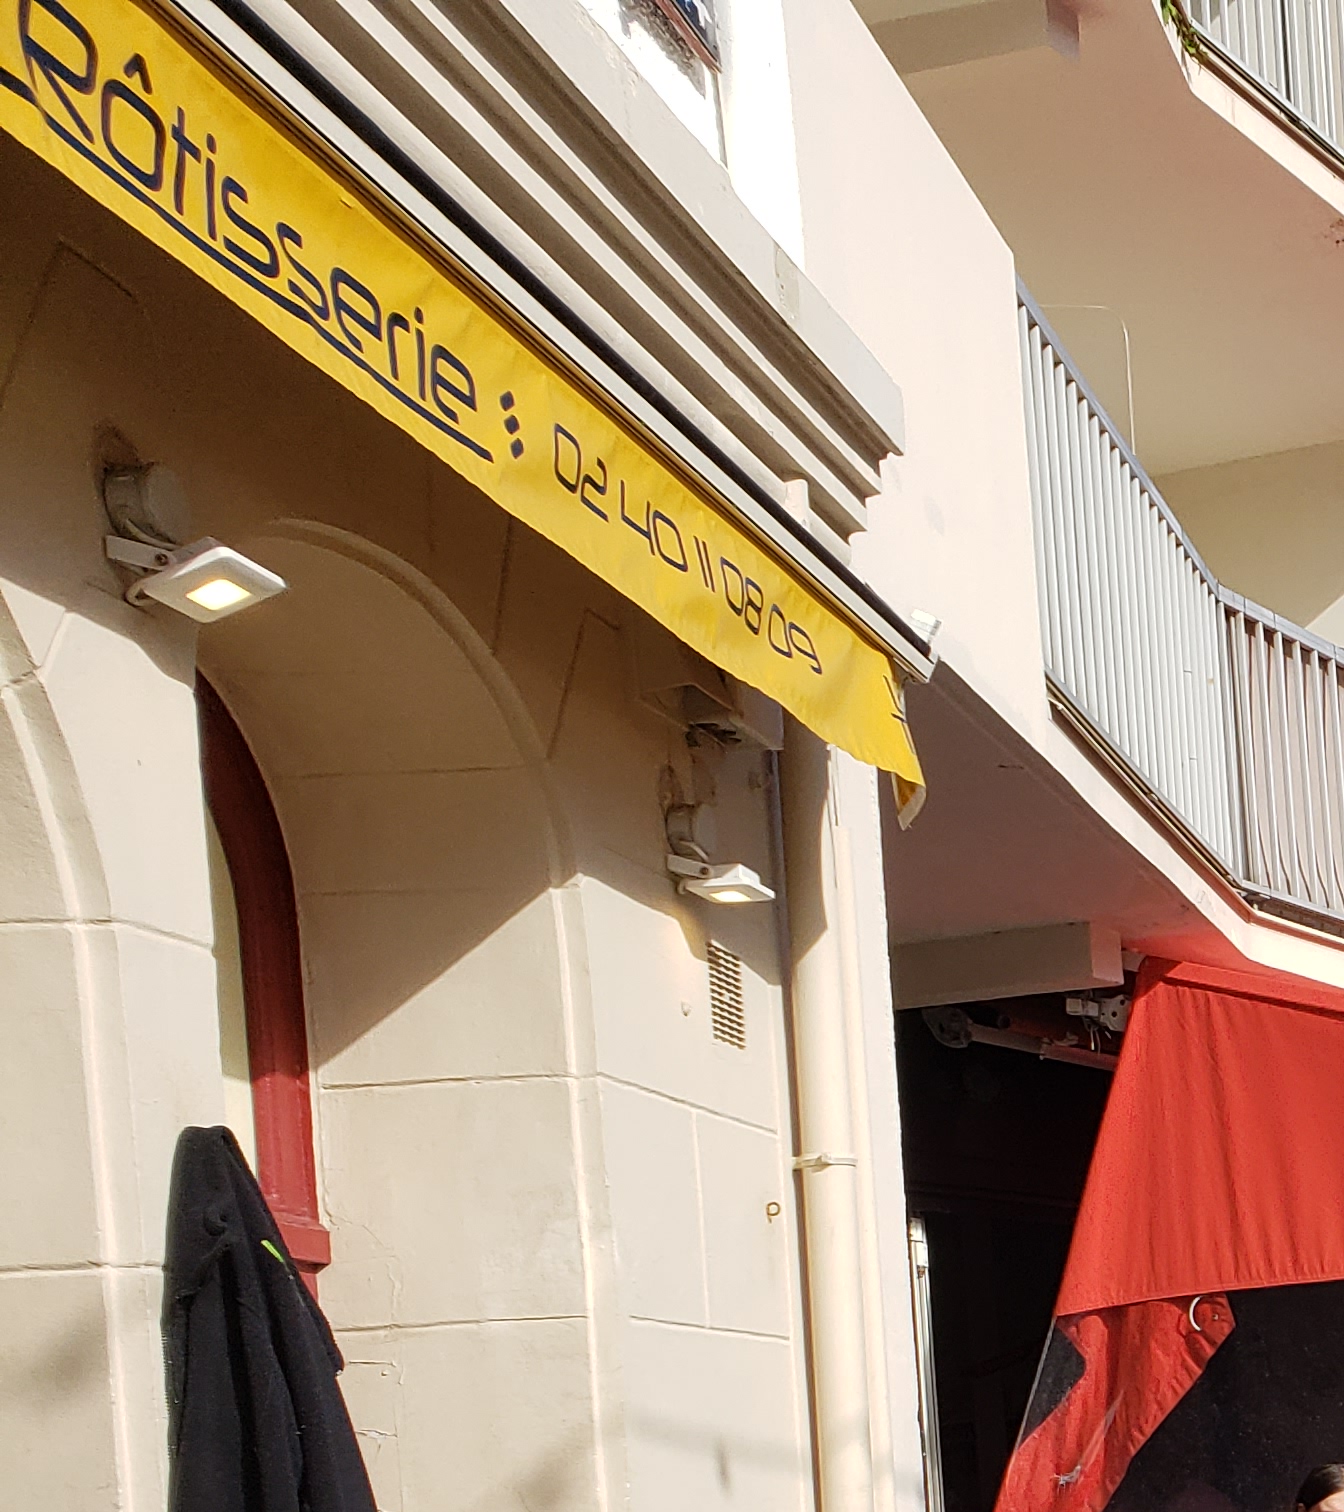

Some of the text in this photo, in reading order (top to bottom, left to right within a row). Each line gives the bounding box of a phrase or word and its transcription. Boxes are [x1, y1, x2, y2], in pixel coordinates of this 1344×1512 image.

[17, 0, 824, 675] Rôtisserie 02 40 11 08 09
